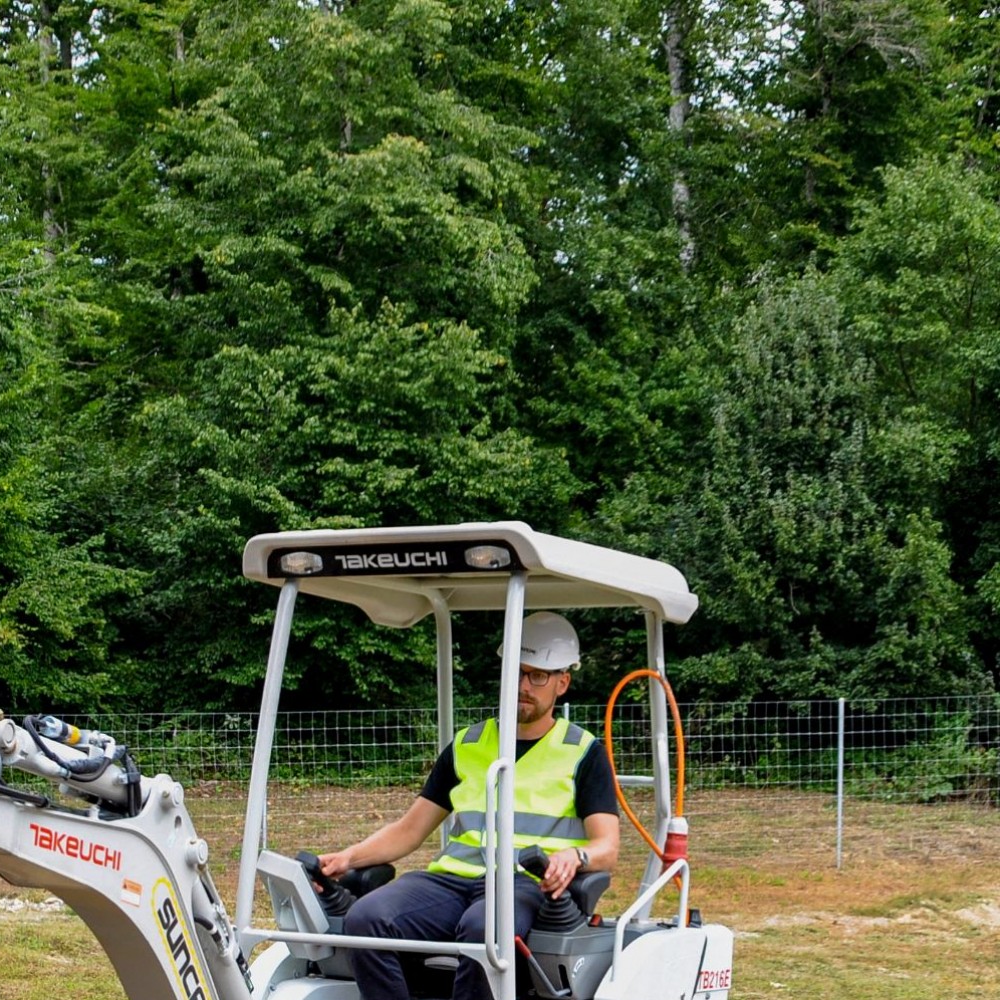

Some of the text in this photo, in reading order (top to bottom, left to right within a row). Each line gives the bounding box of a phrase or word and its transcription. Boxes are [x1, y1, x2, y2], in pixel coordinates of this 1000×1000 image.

[335, 551, 448, 569] TAKEUCHI
[29, 823, 122, 871] TAKEUCHI
[698, 969, 731, 990] TB216E
